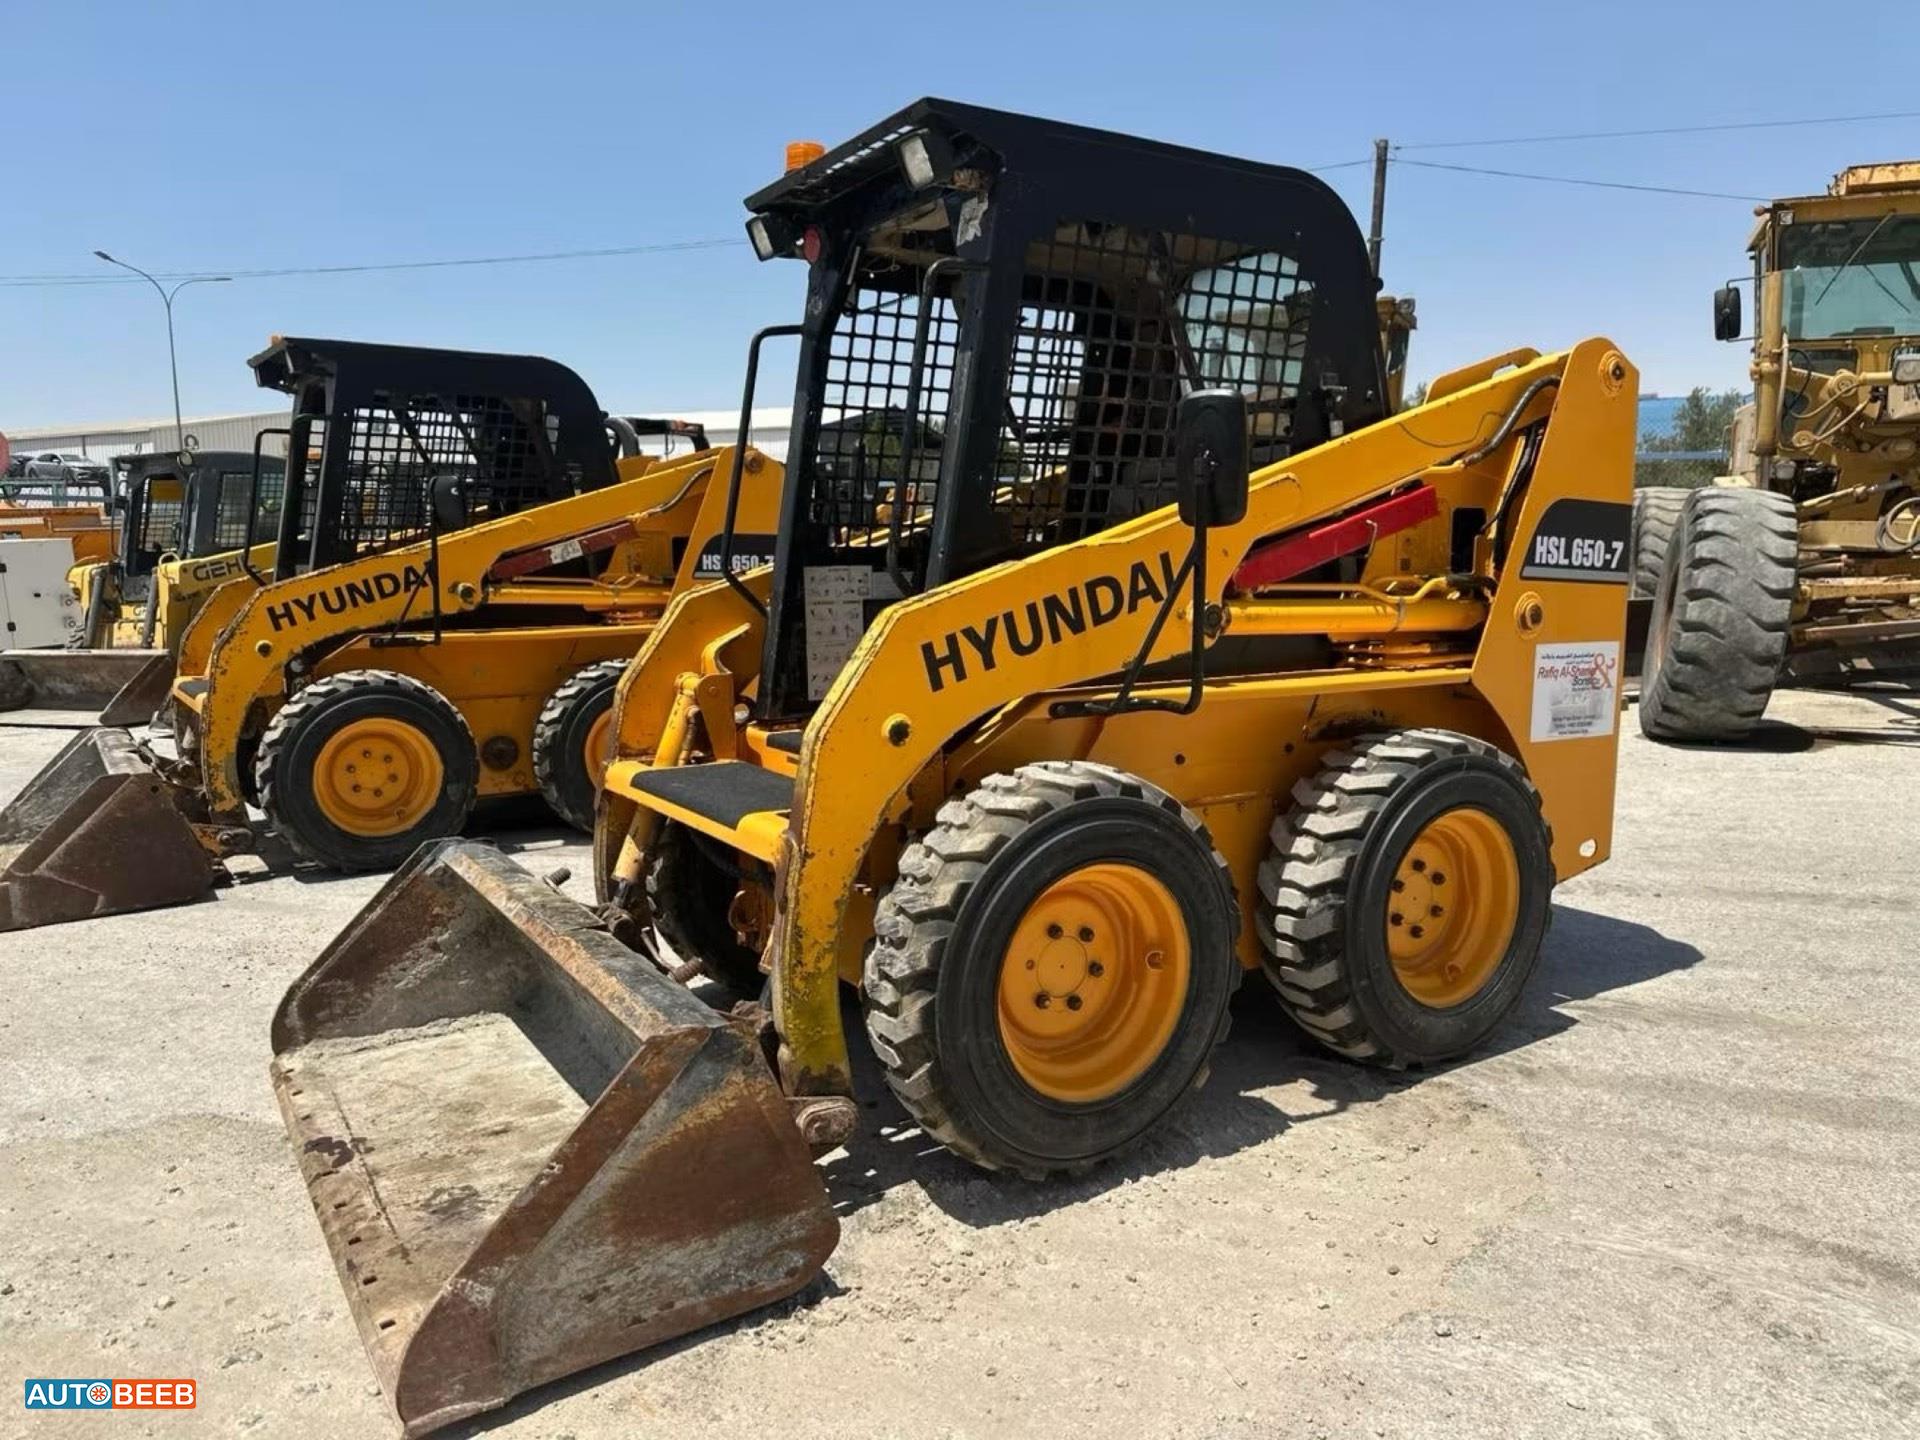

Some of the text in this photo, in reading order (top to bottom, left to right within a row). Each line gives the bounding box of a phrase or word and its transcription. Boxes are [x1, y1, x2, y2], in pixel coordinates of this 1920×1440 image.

[702, 554, 731, 570] HS
[1534, 536, 1624, 569] HSL 650-7
[193, 556, 256, 581] GEH
[920, 552, 1174, 692] HYUNDAI
